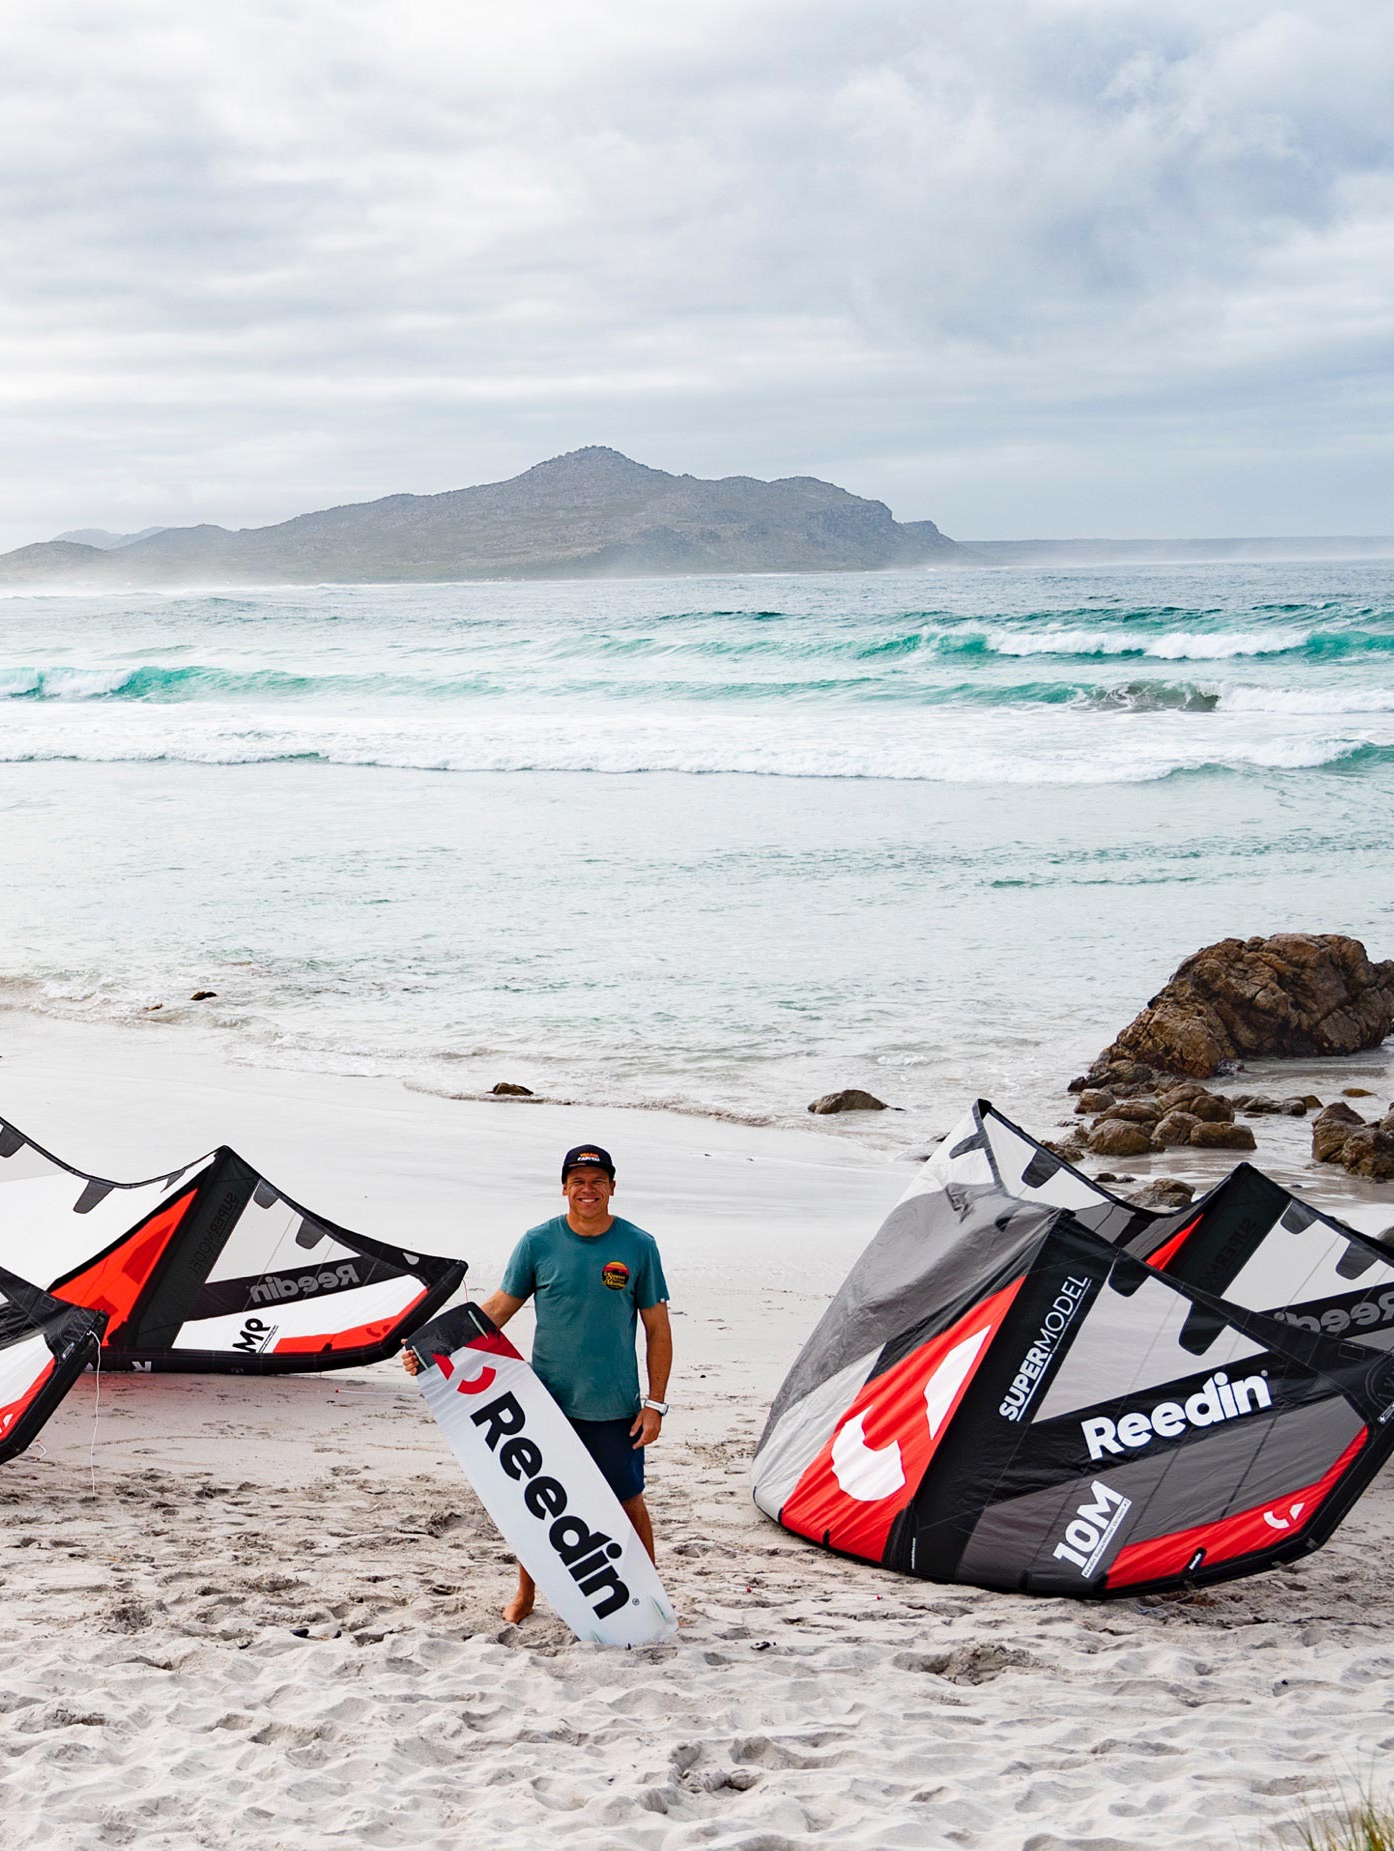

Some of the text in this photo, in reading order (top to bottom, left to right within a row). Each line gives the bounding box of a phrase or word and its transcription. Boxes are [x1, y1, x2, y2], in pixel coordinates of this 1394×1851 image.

[998, 1276, 1088, 1421] SUPERMODEL
[1081, 1372, 1272, 1460] Reedin
[469, 1390, 630, 1620] Reedin
[1052, 1480, 1124, 1568] 10M
